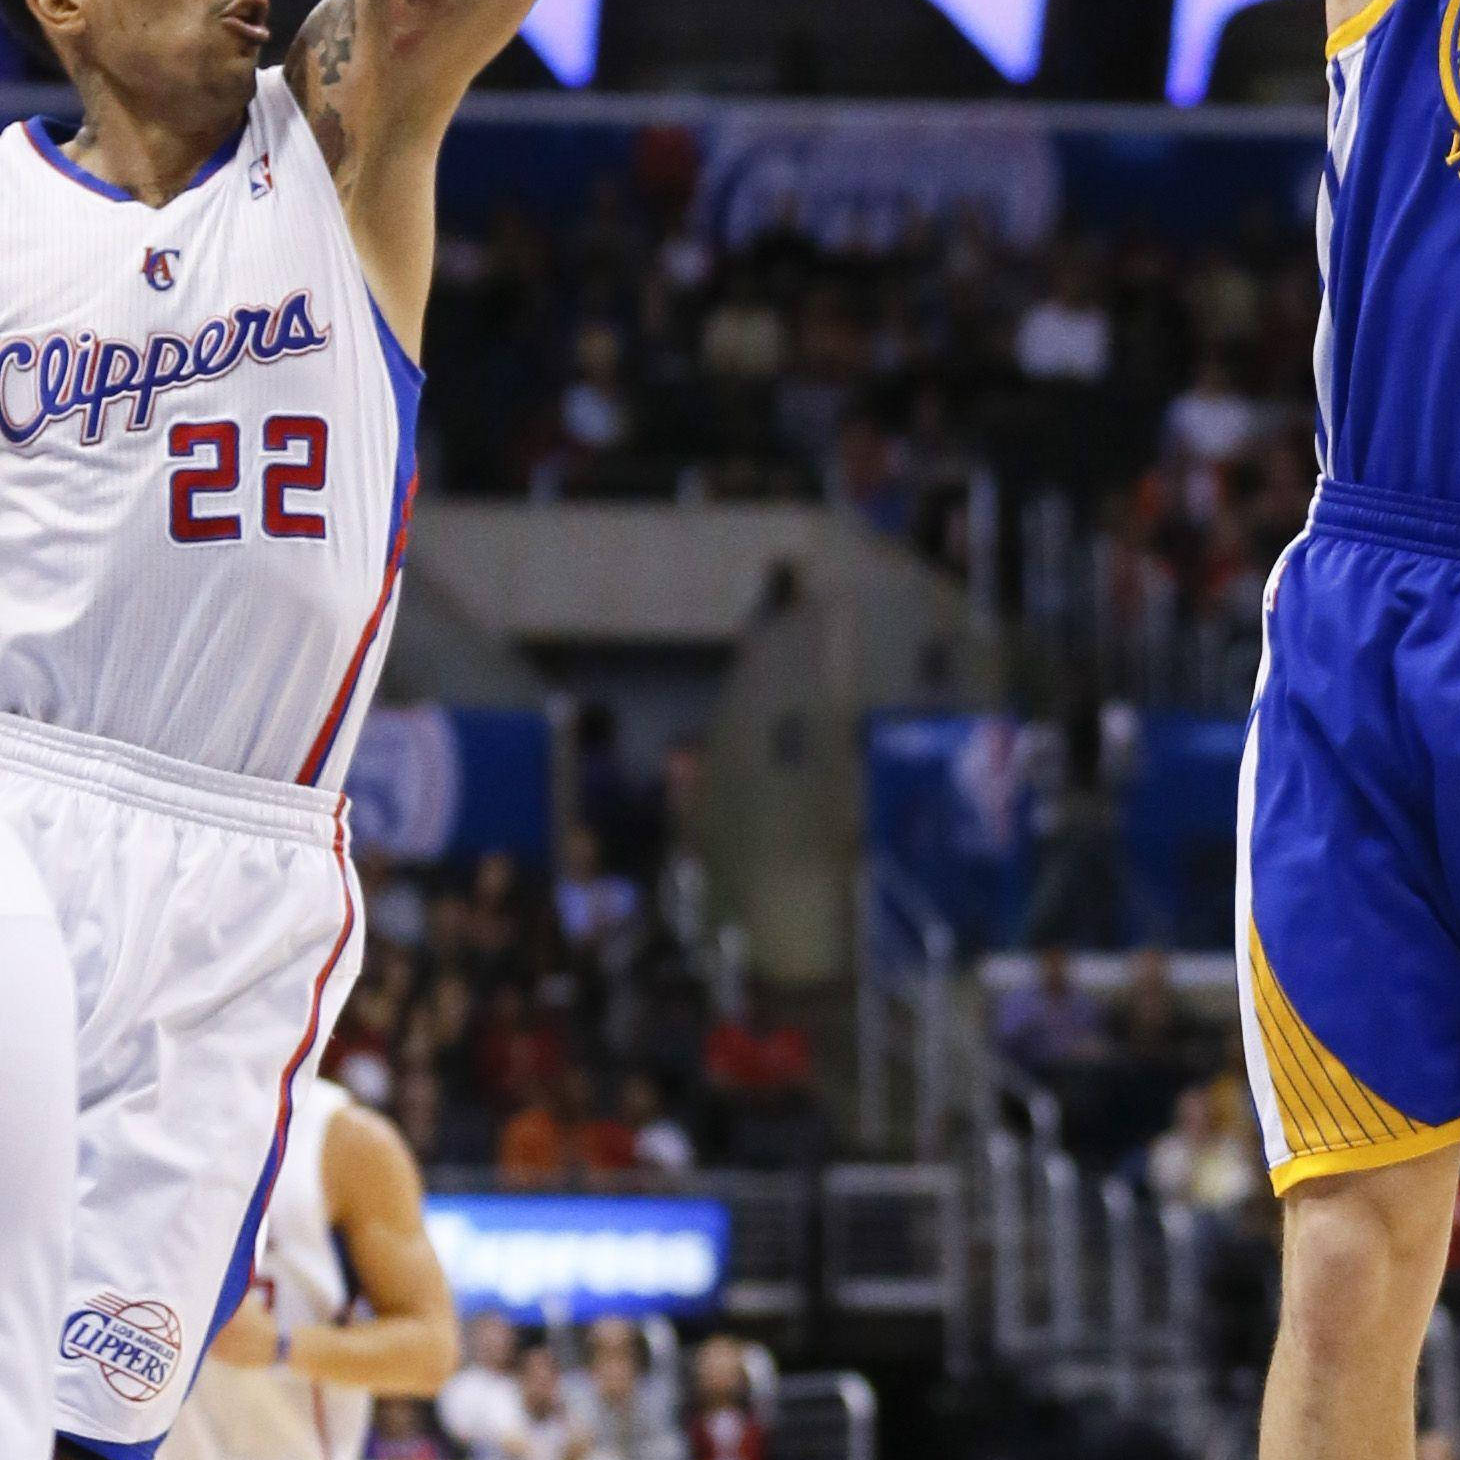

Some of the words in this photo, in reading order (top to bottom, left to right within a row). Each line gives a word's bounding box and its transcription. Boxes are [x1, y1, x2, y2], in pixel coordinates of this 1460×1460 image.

[0, 290, 331, 444] Clippers
[168, 414, 329, 544] 22
[60, 1309, 170, 1384] CLIPPERS
